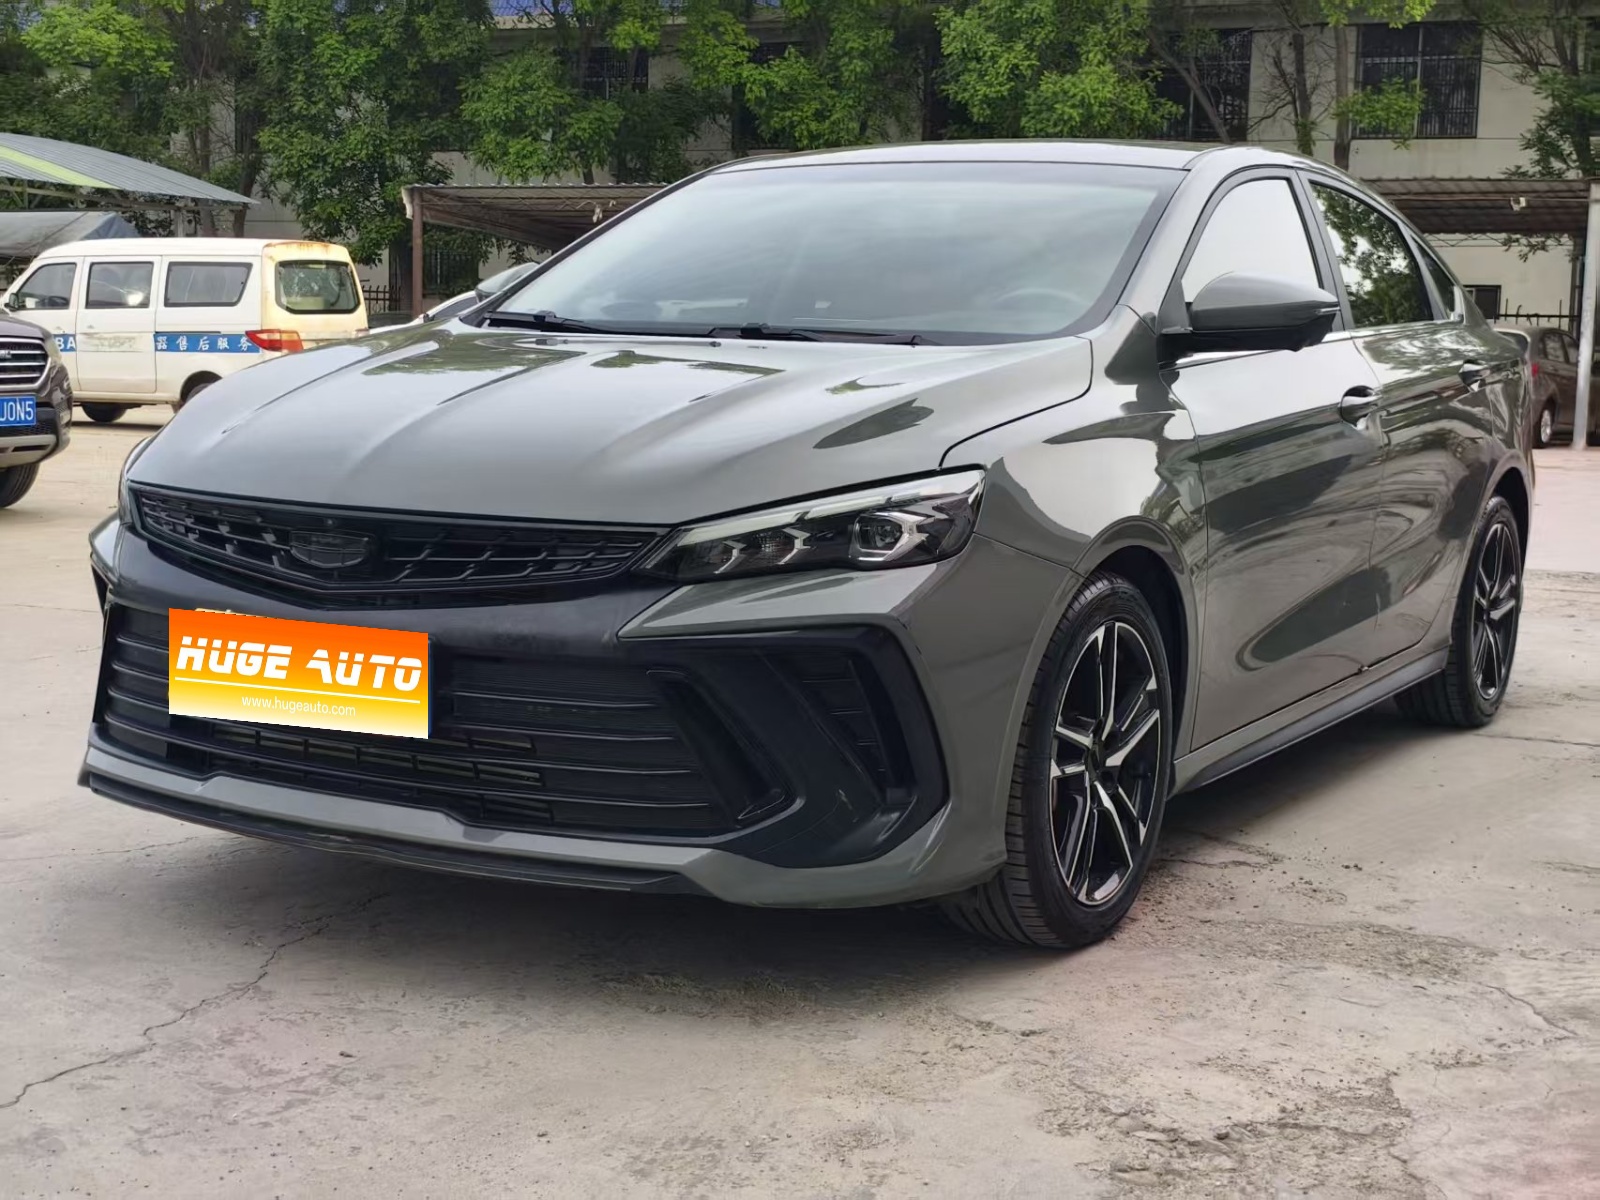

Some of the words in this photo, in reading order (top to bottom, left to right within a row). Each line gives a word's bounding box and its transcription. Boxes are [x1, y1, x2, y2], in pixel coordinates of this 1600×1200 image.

[156, 335, 252, 351] 器售后服务
